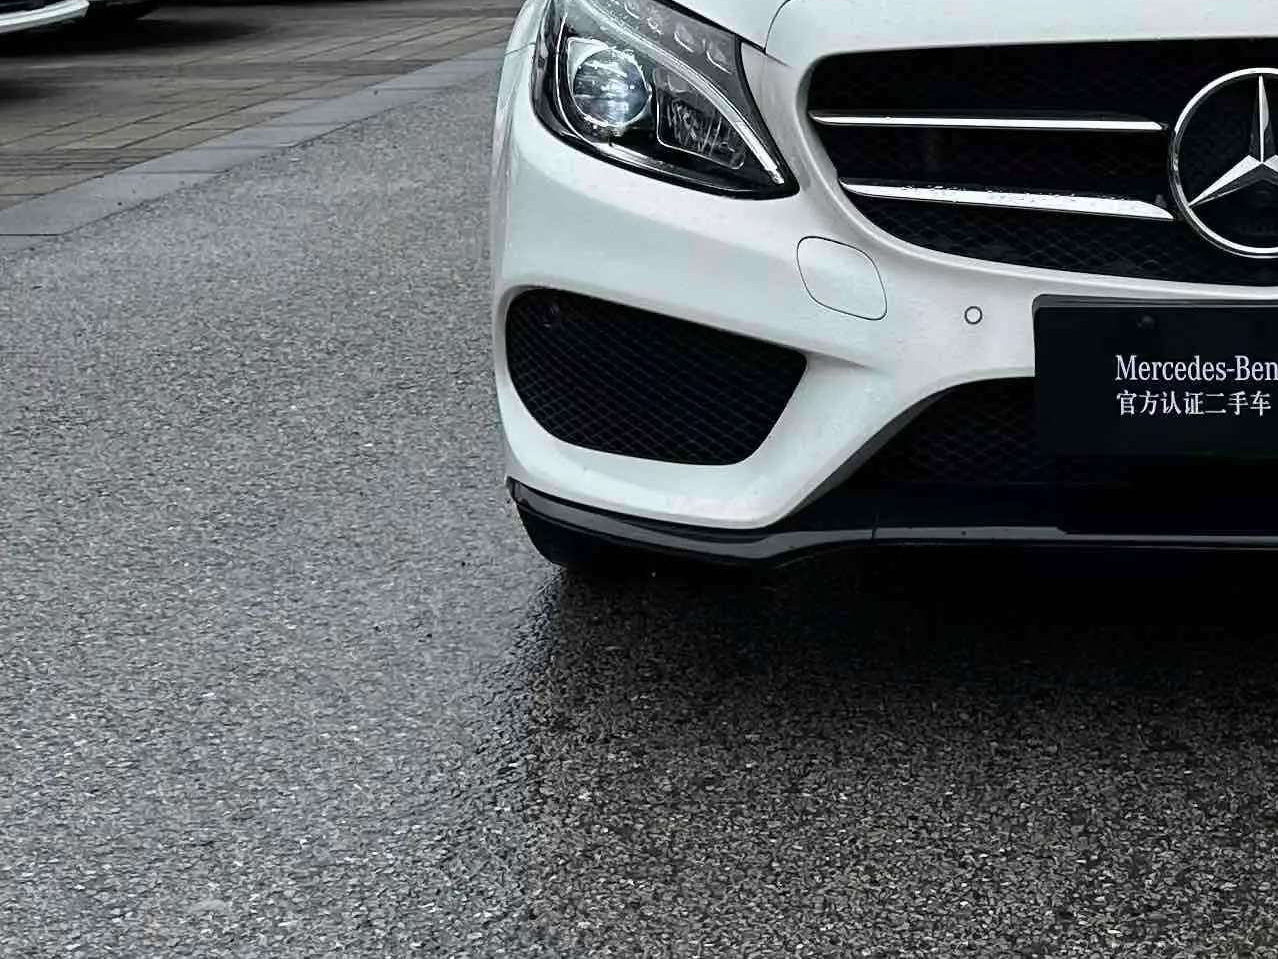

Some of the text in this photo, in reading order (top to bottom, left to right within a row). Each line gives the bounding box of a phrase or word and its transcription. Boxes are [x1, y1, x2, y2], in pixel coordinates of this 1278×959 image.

[1116, 390, 1272, 417] 官方认证二手车
